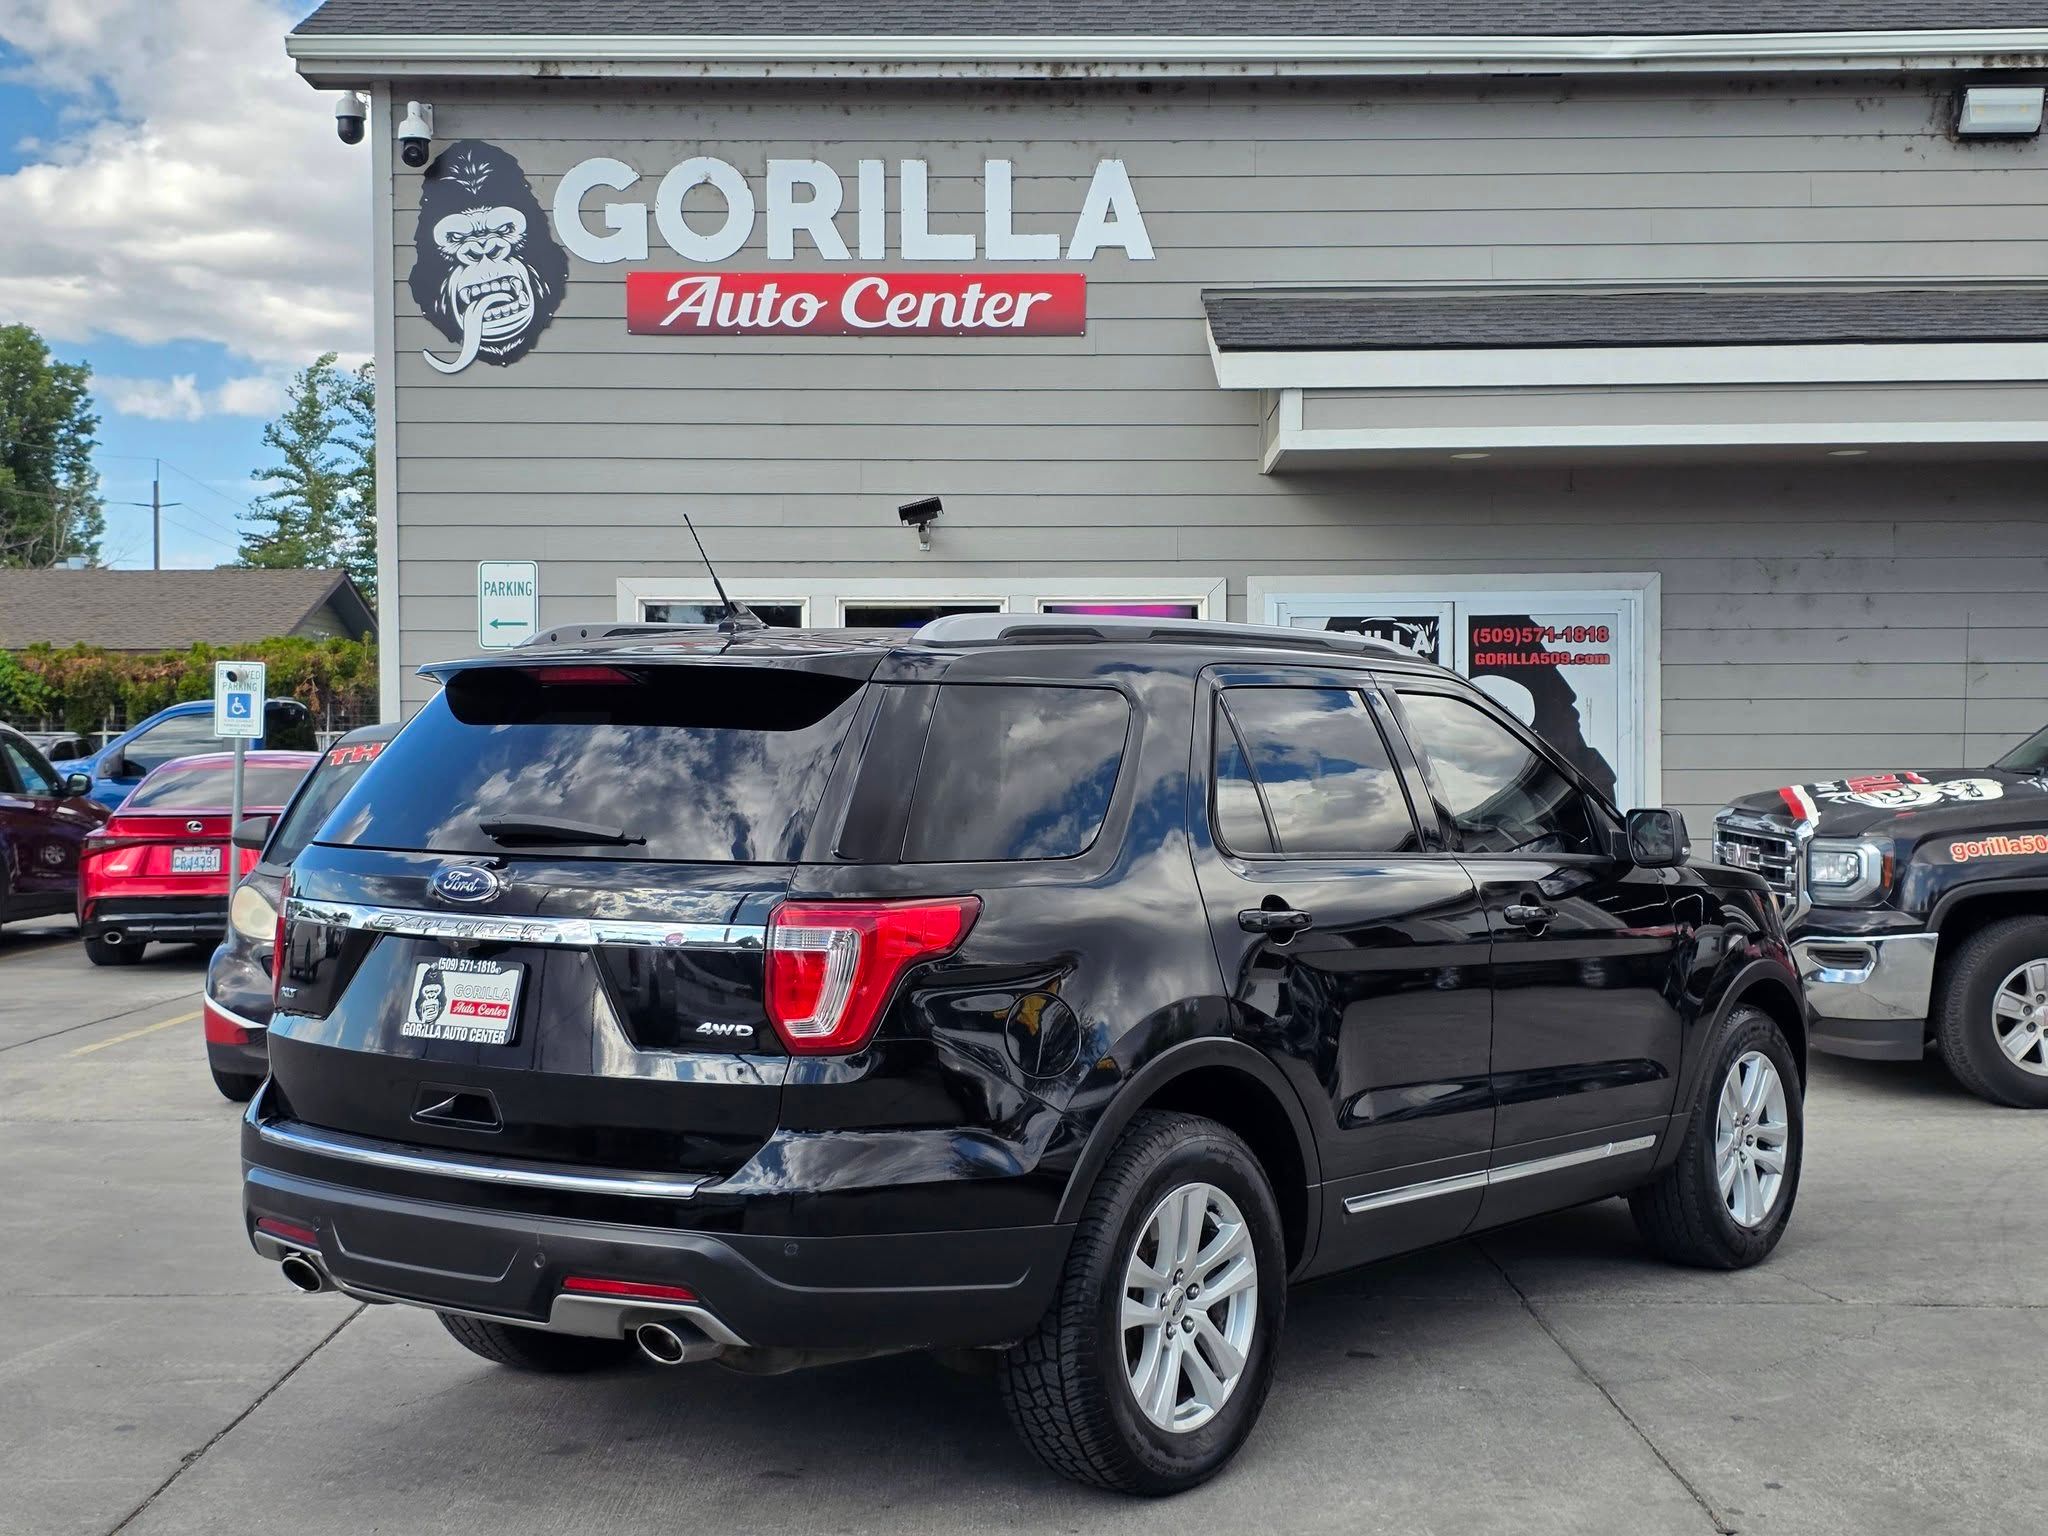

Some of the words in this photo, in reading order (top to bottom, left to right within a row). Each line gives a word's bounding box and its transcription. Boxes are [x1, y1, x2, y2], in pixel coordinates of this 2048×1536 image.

[553, 156, 1156, 263] GORILLA
[660, 275, 828, 328] Auto
[841, 276, 1053, 329] Center
[484, 581, 532, 596] PARKING
[1473, 625, 1610, 647] (509)571-1818
[1475, 651, 1610, 665] GORILLA509.com
[219, 669, 260, 680] RVED
[222, 682, 257, 691] PARKING
[1950, 834, 2048, 862] gorilla50
[443, 870, 480, 893] Ford
[438, 957, 458, 972] (509)
[459, 959, 497, 974] 571-1818
[453, 984, 511, 1001] GORILLA
[452, 1001, 476, 1014] Auto
[478, 1003, 507, 1018] Center
[402, 1022, 441, 1040] GORILLA
[442, 1025, 469, 1042] AUTO
[469, 1028, 507, 1045] CENTER
[696, 1022, 754, 1037] 4WD
